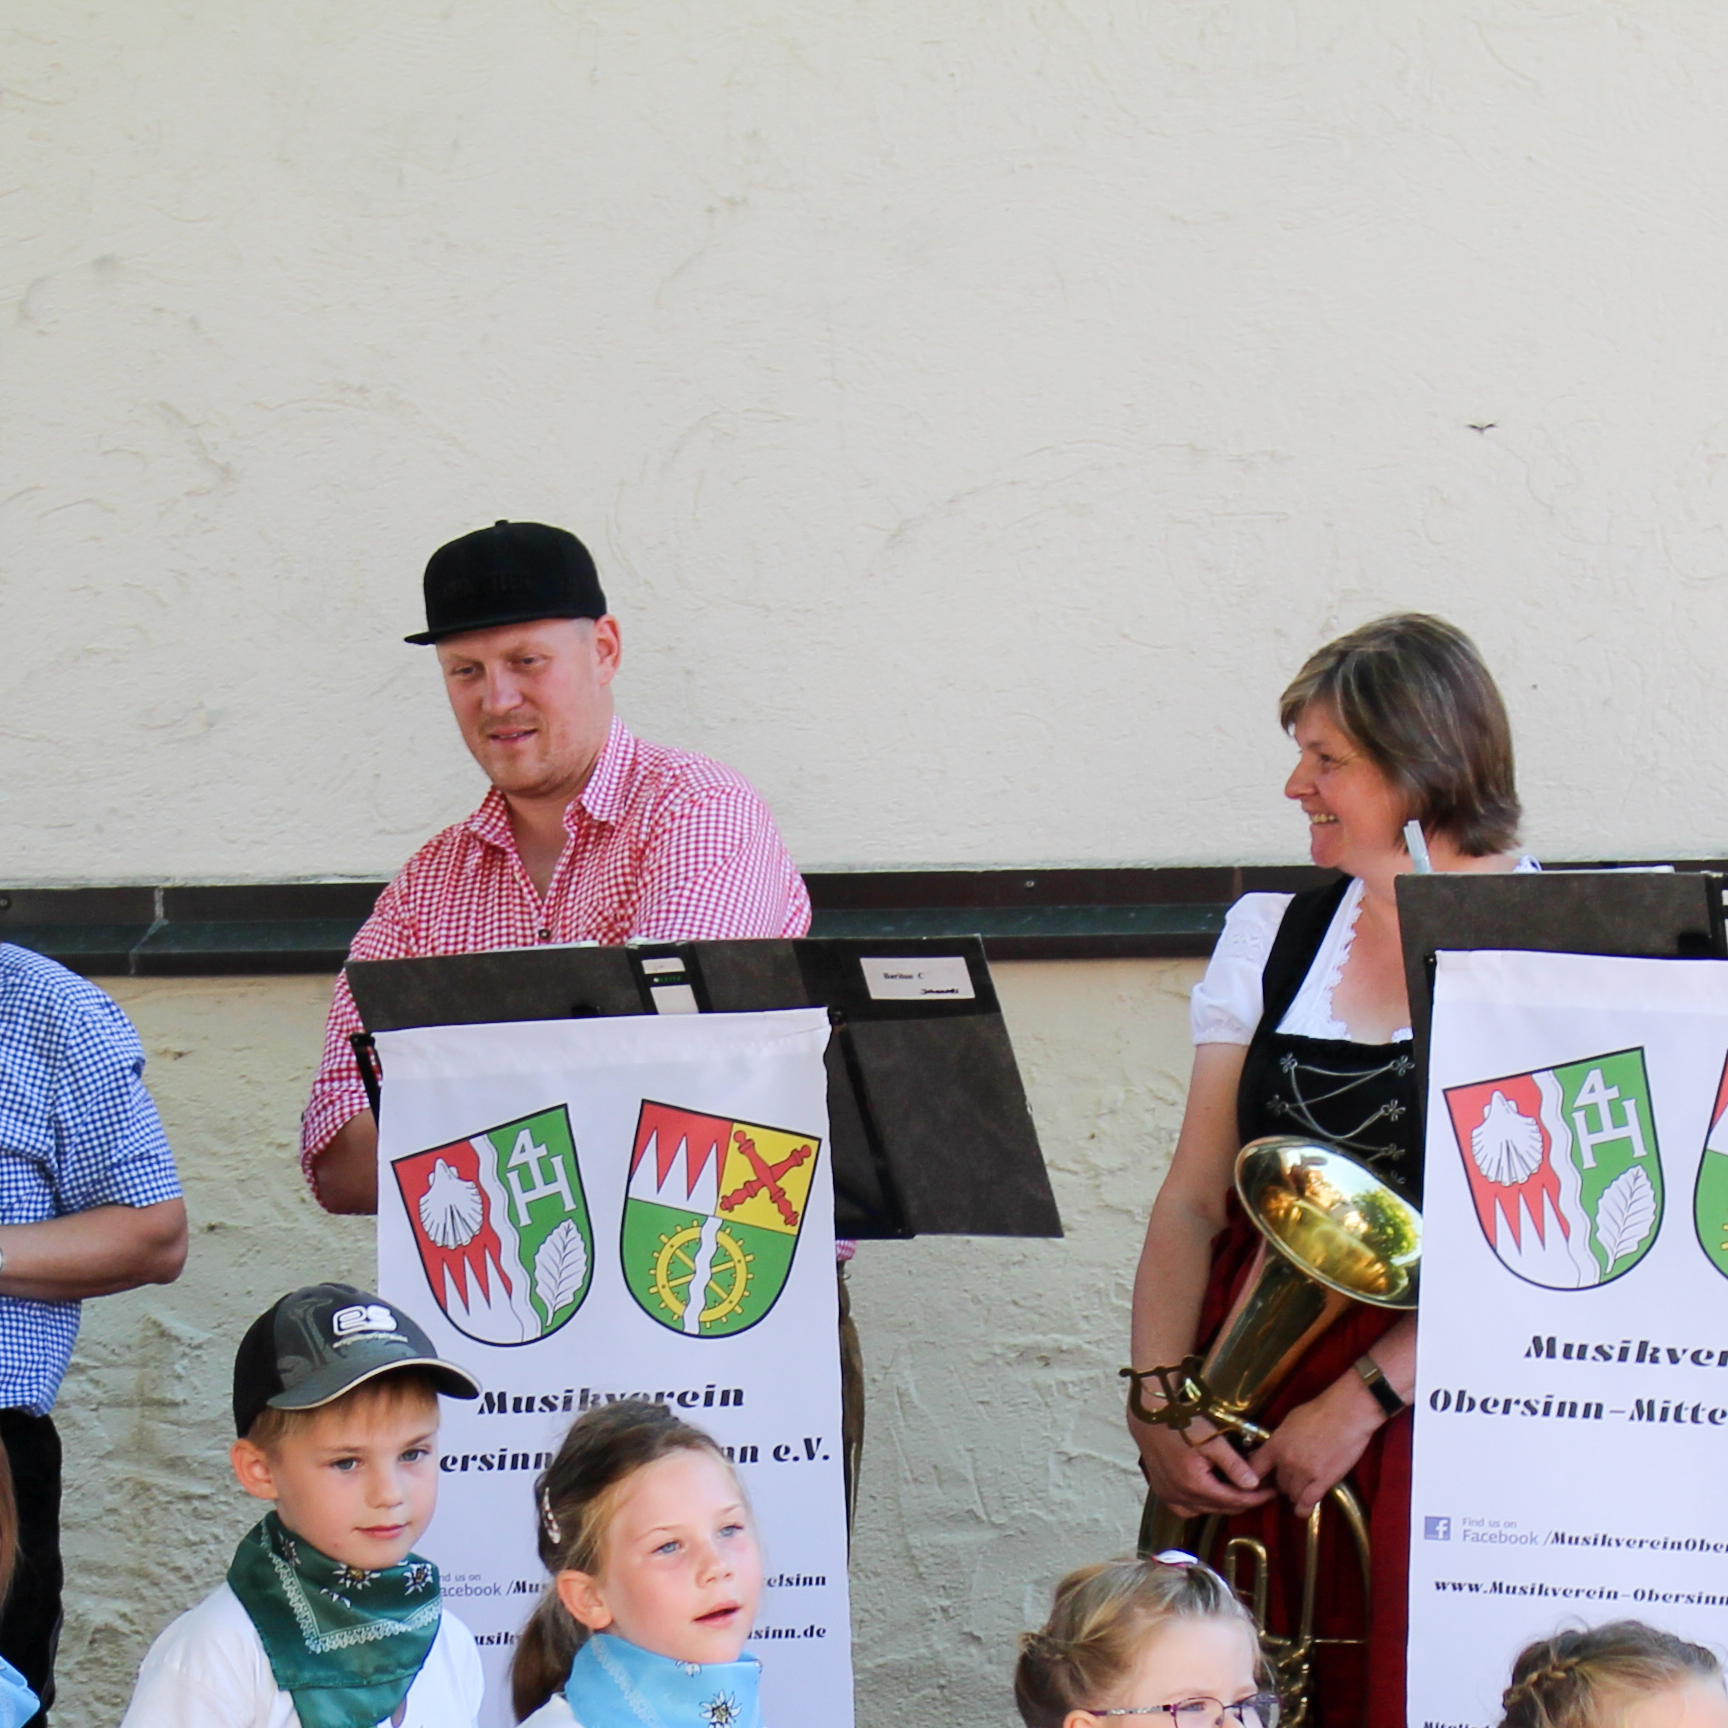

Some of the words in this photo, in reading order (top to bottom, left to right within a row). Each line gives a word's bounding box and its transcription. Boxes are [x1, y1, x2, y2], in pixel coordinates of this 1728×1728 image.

[772, 1437, 831, 1463] e.V.
[1462, 1517, 1485, 1528] Find
[1489, 1519, 1501, 1529] us
[1503, 1520, 1517, 1529] on
[1462, 1529, 1539, 1546] Facebook
[455, 1574, 466, 1582] us
[468, 1573, 481, 1581] on
[440, 1582, 502, 1597] acebook
